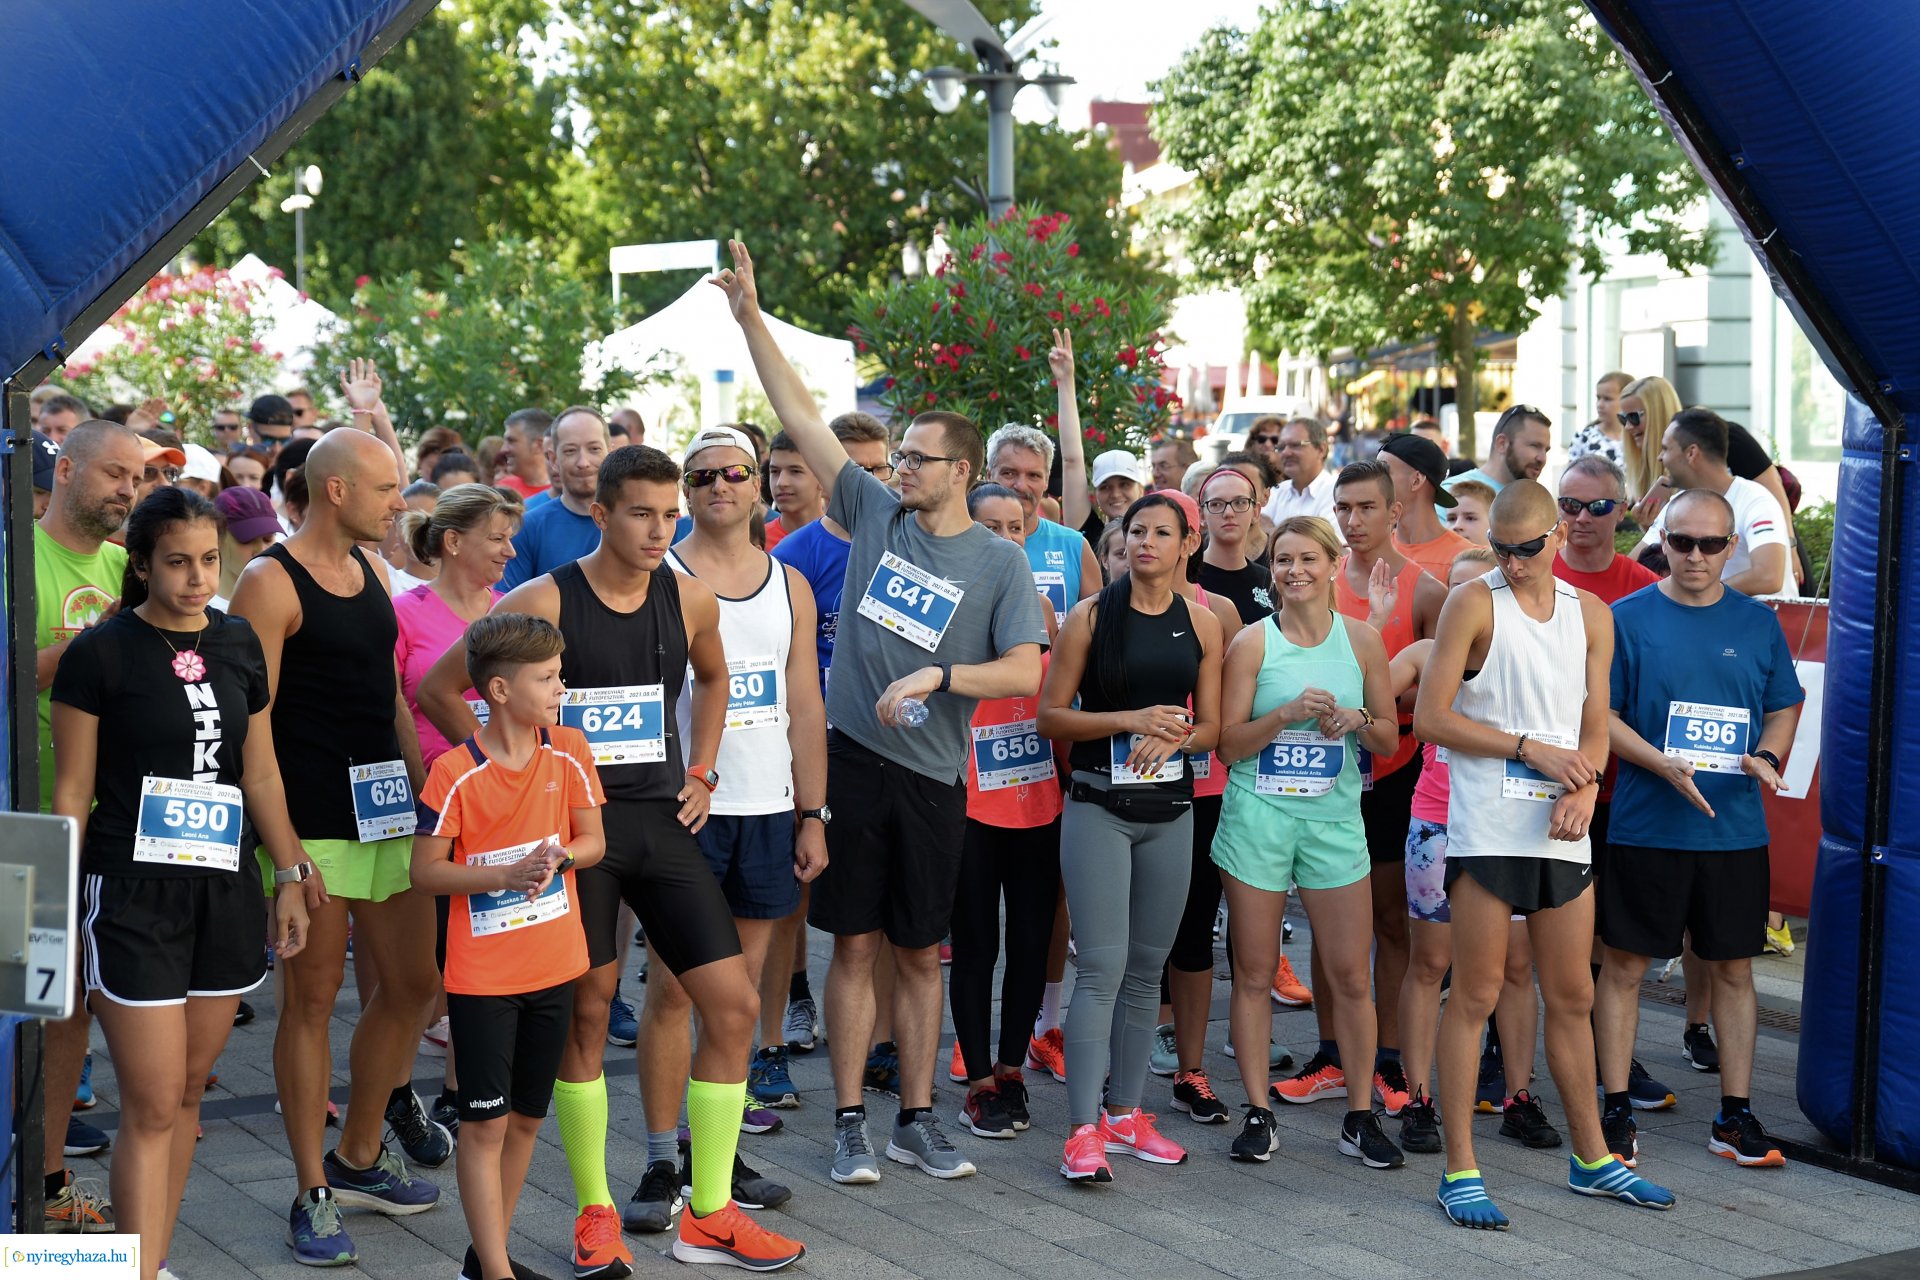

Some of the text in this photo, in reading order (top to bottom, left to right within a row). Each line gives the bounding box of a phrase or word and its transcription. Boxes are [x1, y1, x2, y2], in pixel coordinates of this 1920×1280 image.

[886, 575, 936, 615] 641
[729, 673, 764, 699] 60
[582, 704, 643, 732] 624
[1685, 719, 1737, 745] 596
[992, 734, 1040, 761] 656
[1273, 745, 1326, 769] 582
[370, 778, 408, 806] 629
[163, 799, 229, 832] 590
[36, 967, 55, 1000] 7
[469, 1096, 504, 1109] uhlsport
